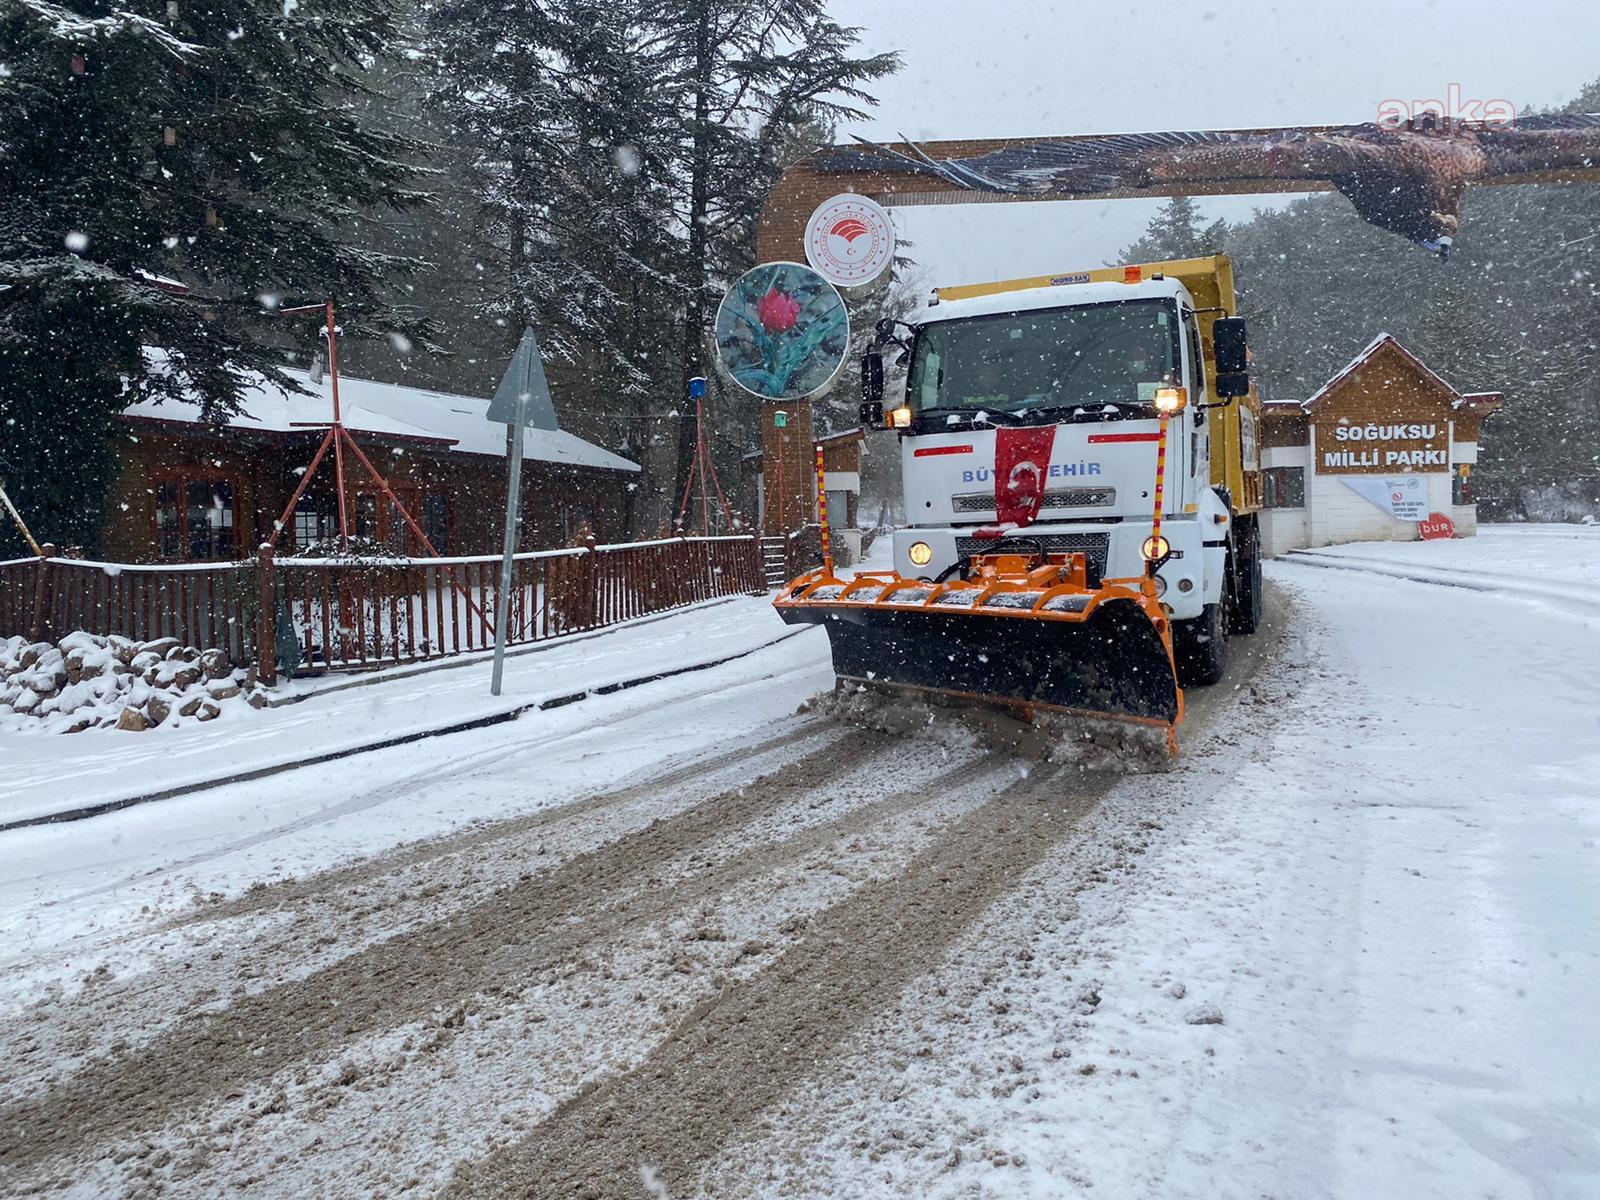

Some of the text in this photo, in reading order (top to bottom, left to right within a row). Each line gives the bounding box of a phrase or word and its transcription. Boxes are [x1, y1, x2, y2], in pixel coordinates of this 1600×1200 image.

[1335, 422, 1436, 441] SOĞUKSU
[1324, 449, 1447, 467] MİLLİ PARKI
[1423, 523, 1449, 533] DUR
